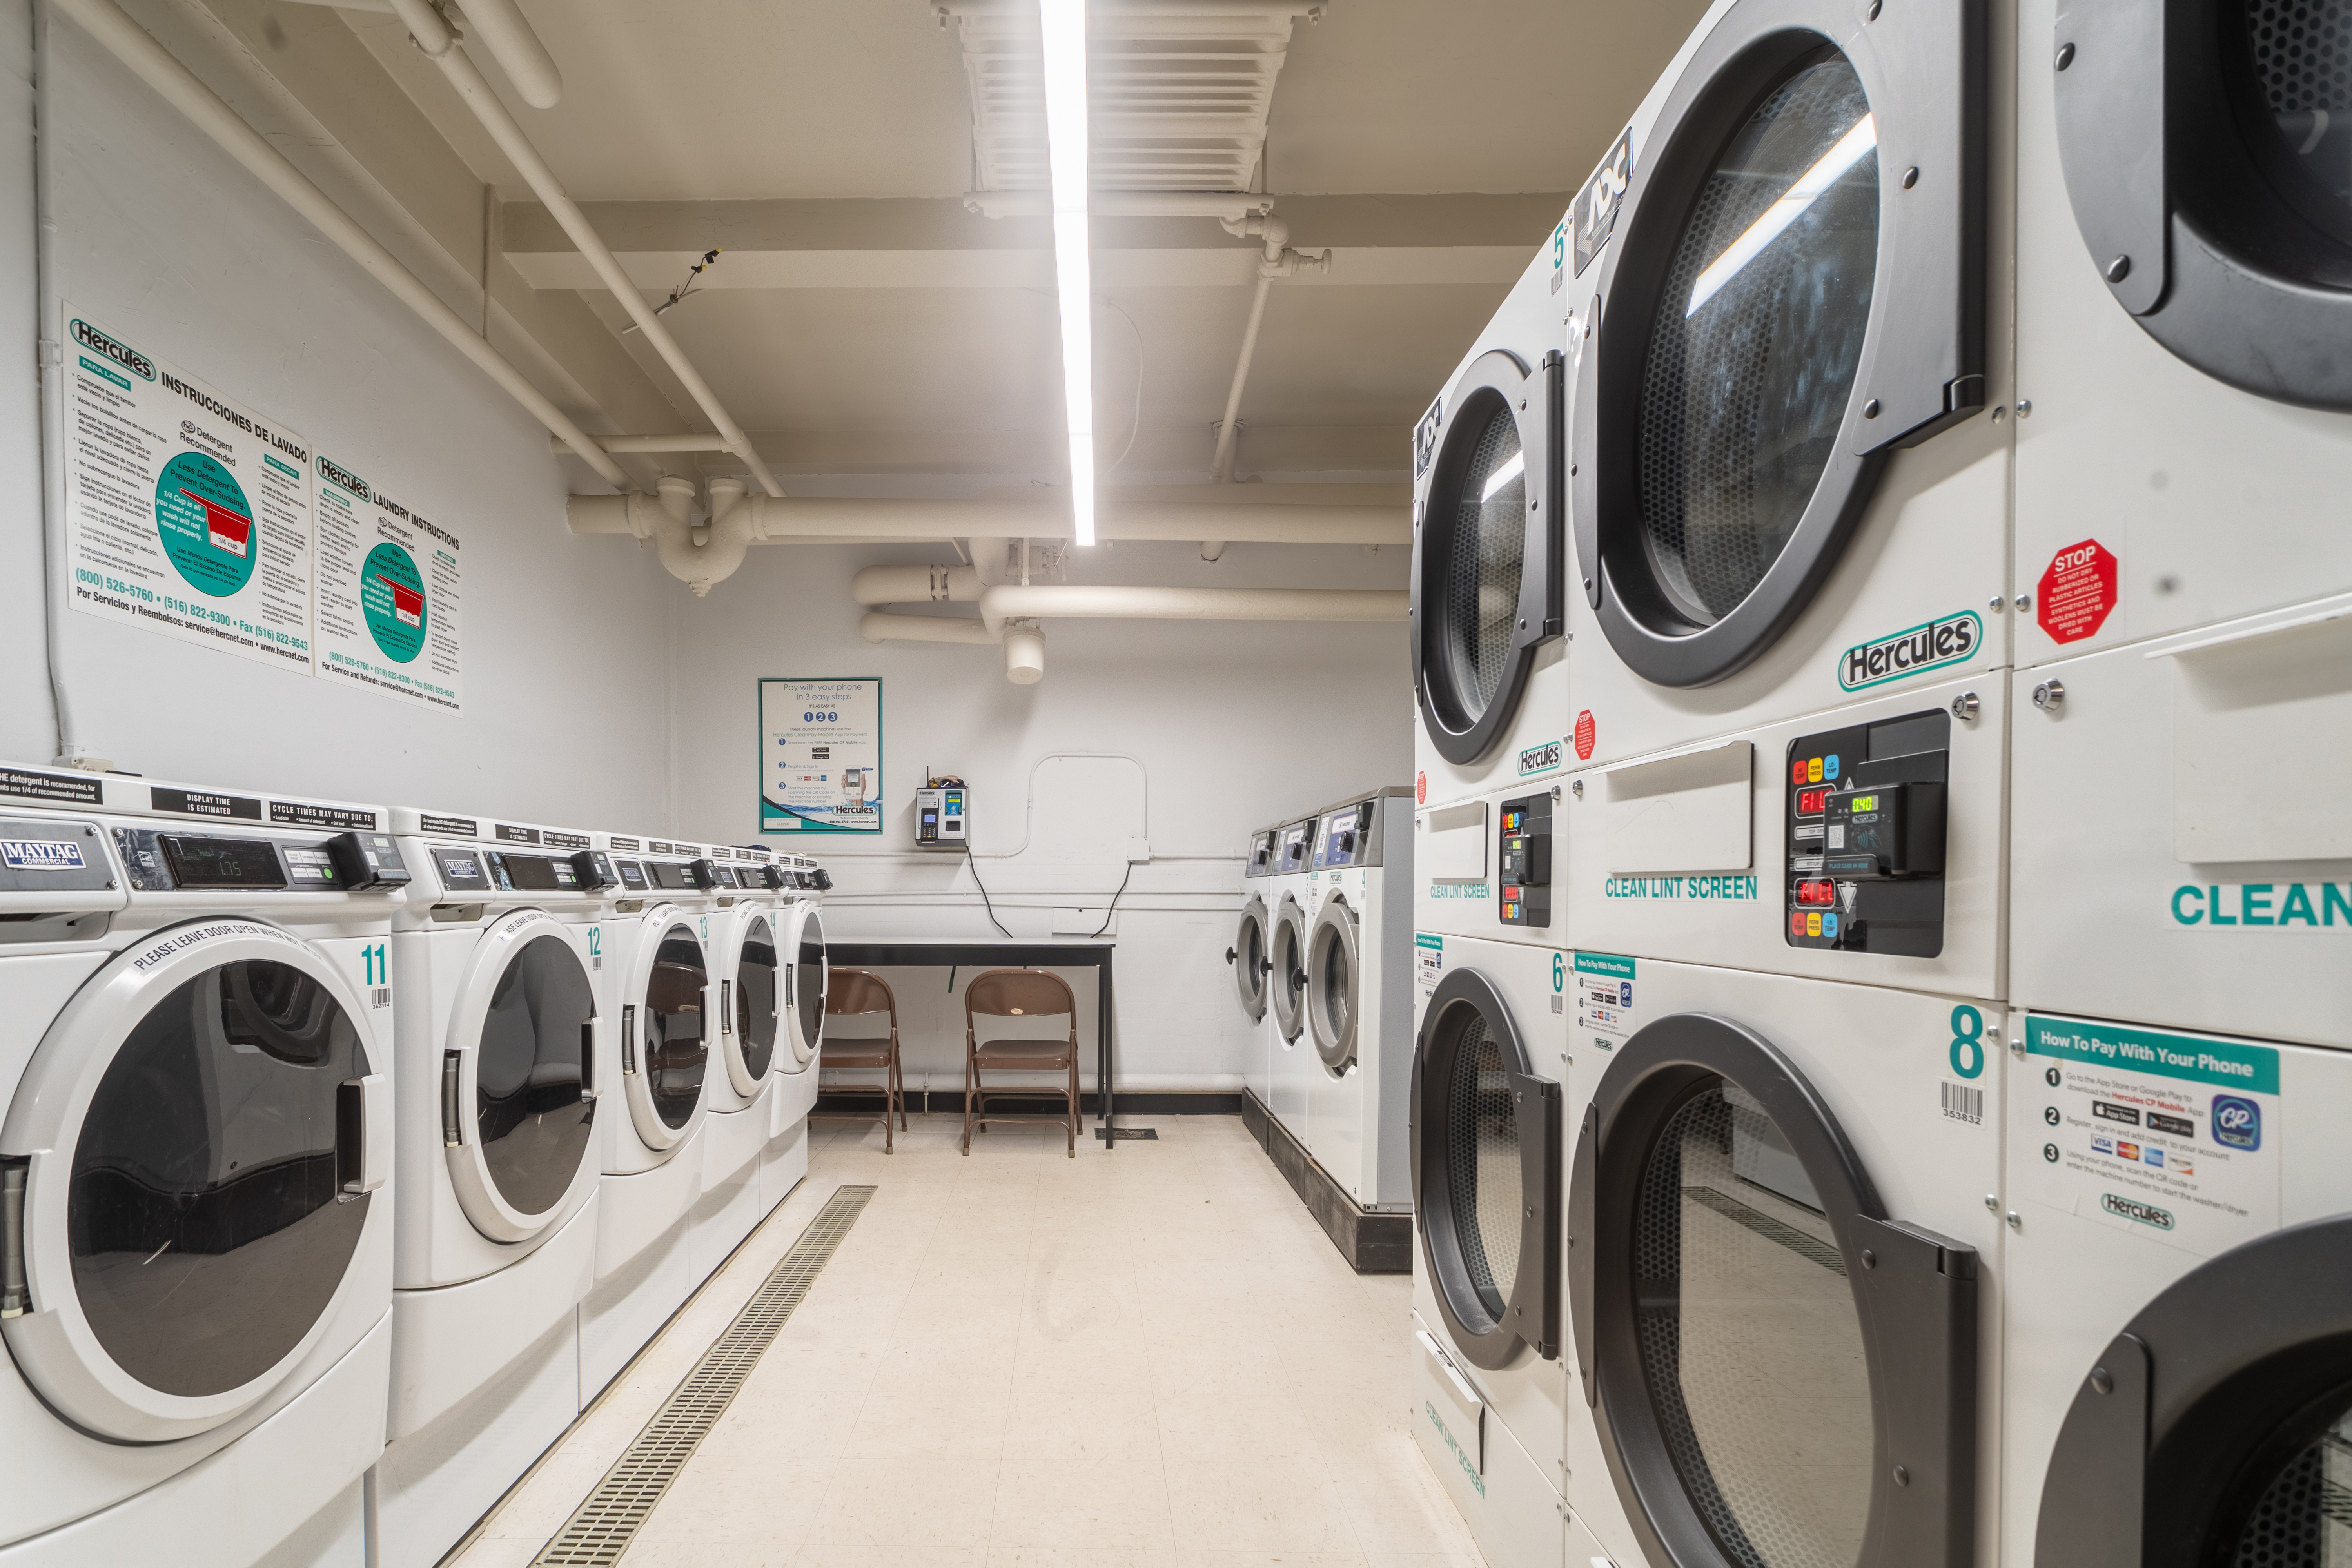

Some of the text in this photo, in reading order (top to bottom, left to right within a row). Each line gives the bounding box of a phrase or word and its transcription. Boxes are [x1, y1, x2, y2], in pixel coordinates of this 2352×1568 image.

[1588, 143, 1626, 236] ADC
[1554, 222, 1564, 269] 5
[79, 322, 151, 377] Hercules
[82, 359, 128, 387] PARA LAVAR
[162, 371, 307, 463] INSTRUCCIONES DE LAVADO
[180, 431, 236, 467] Recommended
[196, 426, 232, 453] Detergent
[202, 459, 216, 473] Use
[178, 460, 238, 495] Less Detergent To
[321, 458, 368, 498] Hercules
[170, 468, 245, 510] Prevent Over-Sudsing.
[373, 491, 459, 550] LAUNDRY INSTRUCTIONS
[2056, 545, 2096, 572] STOP
[2068, 572, 2080, 581] NOT
[2080, 567, 2093, 576] DRY
[2049, 581, 2103, 603] PLASTIC ARTICLES
[2053, 578, 2089, 593] RUBBERIZED
[76, 567, 308, 651] (800) 526-5760 (516) 822-9300 Fax (516) 822-9543
[2048, 612, 2076, 624] WOOLENS
[2077, 607, 2093, 615] MUST
[2051, 600, 2086, 615] SYNTHETICS
[77, 586, 309, 664] Por Servicios y Reembolsos: service@hercnet.com www.hercnet.com
[2058, 615, 2092, 630] DRIED WITH
[2066, 626, 2083, 636] CARE
[1849, 620, 1971, 683] Hercules
[321, 661, 460, 710] For Service and Refunds: service@hercnet.com www.hercnet.com
[329, 651, 454, 699] (800) 526-5760 (516) 822-9300 Fax (516) 822-9543
[784, 684, 798, 692] Pay
[836, 683, 862, 692] phone
[831, 693, 851, 701] steps
[818, 713, 824, 721] 2
[830, 713, 835, 721] 3
[1521, 744, 1559, 773] Hercules
[9, 774, 43, 786] detergent
[43, 777, 50, 786] is
[50, 781, 88, 792] recommended,
[187, 794, 230, 806] DISPLAY TIME
[196, 805, 231, 815] ESTIMATED
[835, 805, 873, 814] Hercules
[1852, 797, 1872, 813] 0.40
[272, 804, 294, 814] CYCLE
[296, 807, 316, 816] TIMES
[318, 809, 332, 818] MAY
[333, 811, 349, 820] VARY
[1855, 814, 1877, 822] Hercules
[3, 842, 78, 859] MAYTAG
[220, 862, 241, 876] 1.75
[448, 860, 474, 871] MAYTAG
[1330, 871, 1341, 882] Hercules
[1362, 869, 1365, 888] 4
[1606, 875, 1757, 899] CLEAN LINT SCREEN
[1431, 884, 1490, 898] CLEAN LINT SCREEN
[1801, 883, 1834, 900] FILL
[2171, 882, 2352, 926] CLEAN
[700, 916, 708, 938] 13
[770, 912, 776, 929] 14
[134, 942, 176, 970] PLEASE
[172, 930, 207, 948] LEAVE
[204, 926, 232, 937] DOOR
[233, 925, 258, 934] OPEN
[258, 927, 285, 940] WHEN
[285, 935, 302, 947] NOT
[588, 927, 601, 956] 12
[361, 944, 385, 985] 11
[1553, 953, 1563, 993] 6
[1950, 1005, 1984, 1079] 8
[2040, 1030, 2254, 1077] How To Pay With Your Phone
[1943, 1109, 1981, 1125] 353832
[2094, 1138, 2111, 1148] VISA
[2107, 1194, 2169, 1227] Hercules
[1426, 1400, 1485, 1500] CLEAN LINT SCREEN
